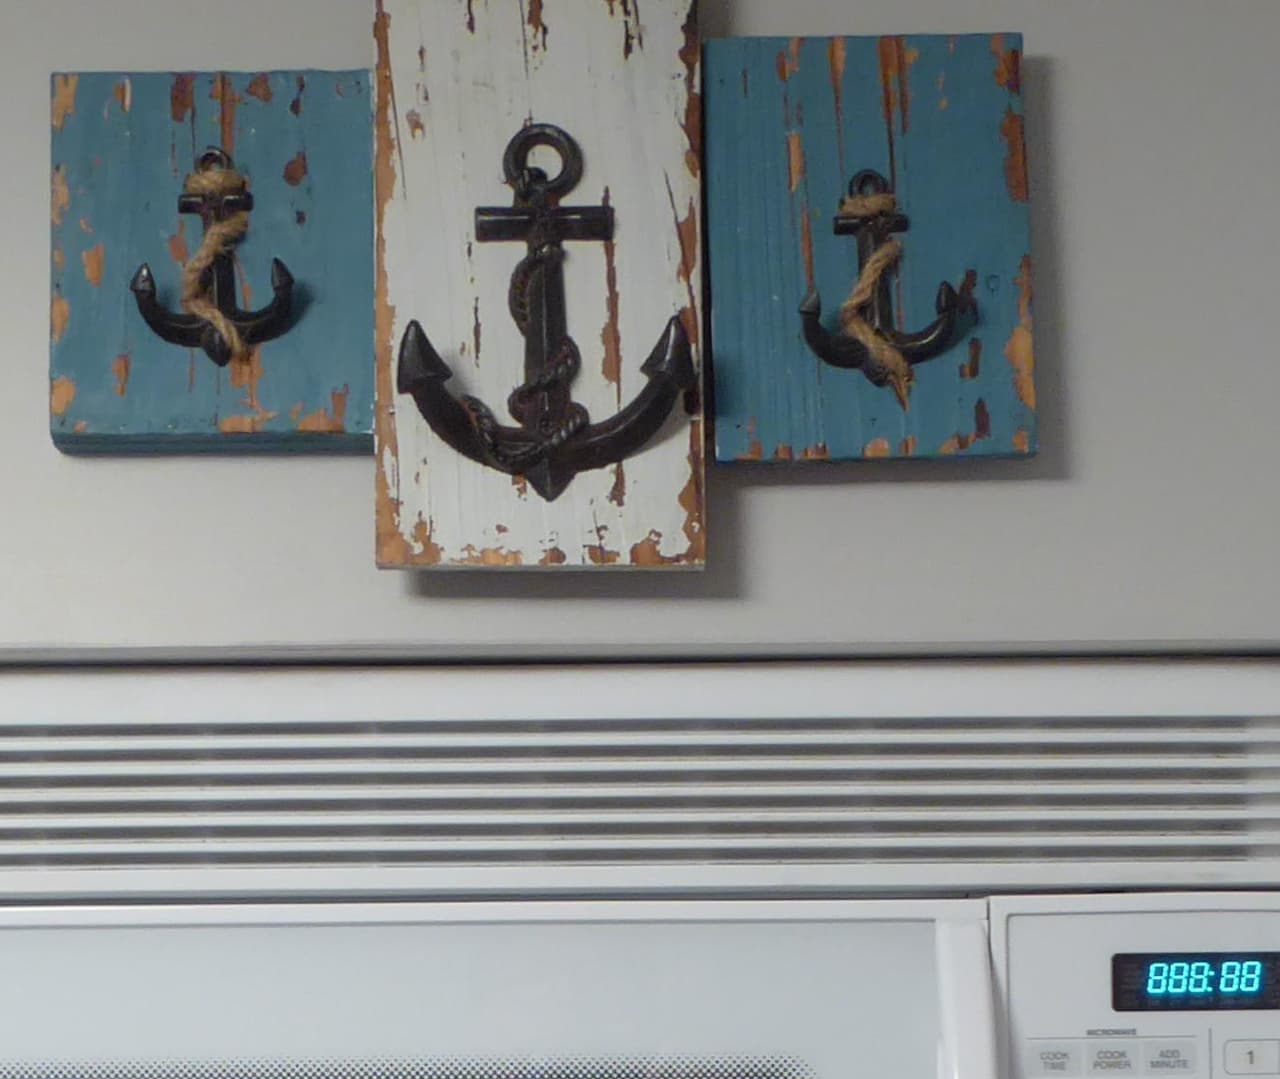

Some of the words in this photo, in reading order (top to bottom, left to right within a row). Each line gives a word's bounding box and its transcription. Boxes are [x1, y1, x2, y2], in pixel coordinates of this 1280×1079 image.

[1147, 961, 1261, 993] 888:88
[1040, 1052, 1069, 1060] COOK
[1097, 1051, 1126, 1059] COOK
[1159, 1050, 1180, 1058] ADD
[1247, 1050, 1254, 1065] 1
[1043, 1062, 1067, 1071] TIME
[1093, 1061, 1131, 1070] POWER
[1150, 1060, 1189, 1069] MINUTE
